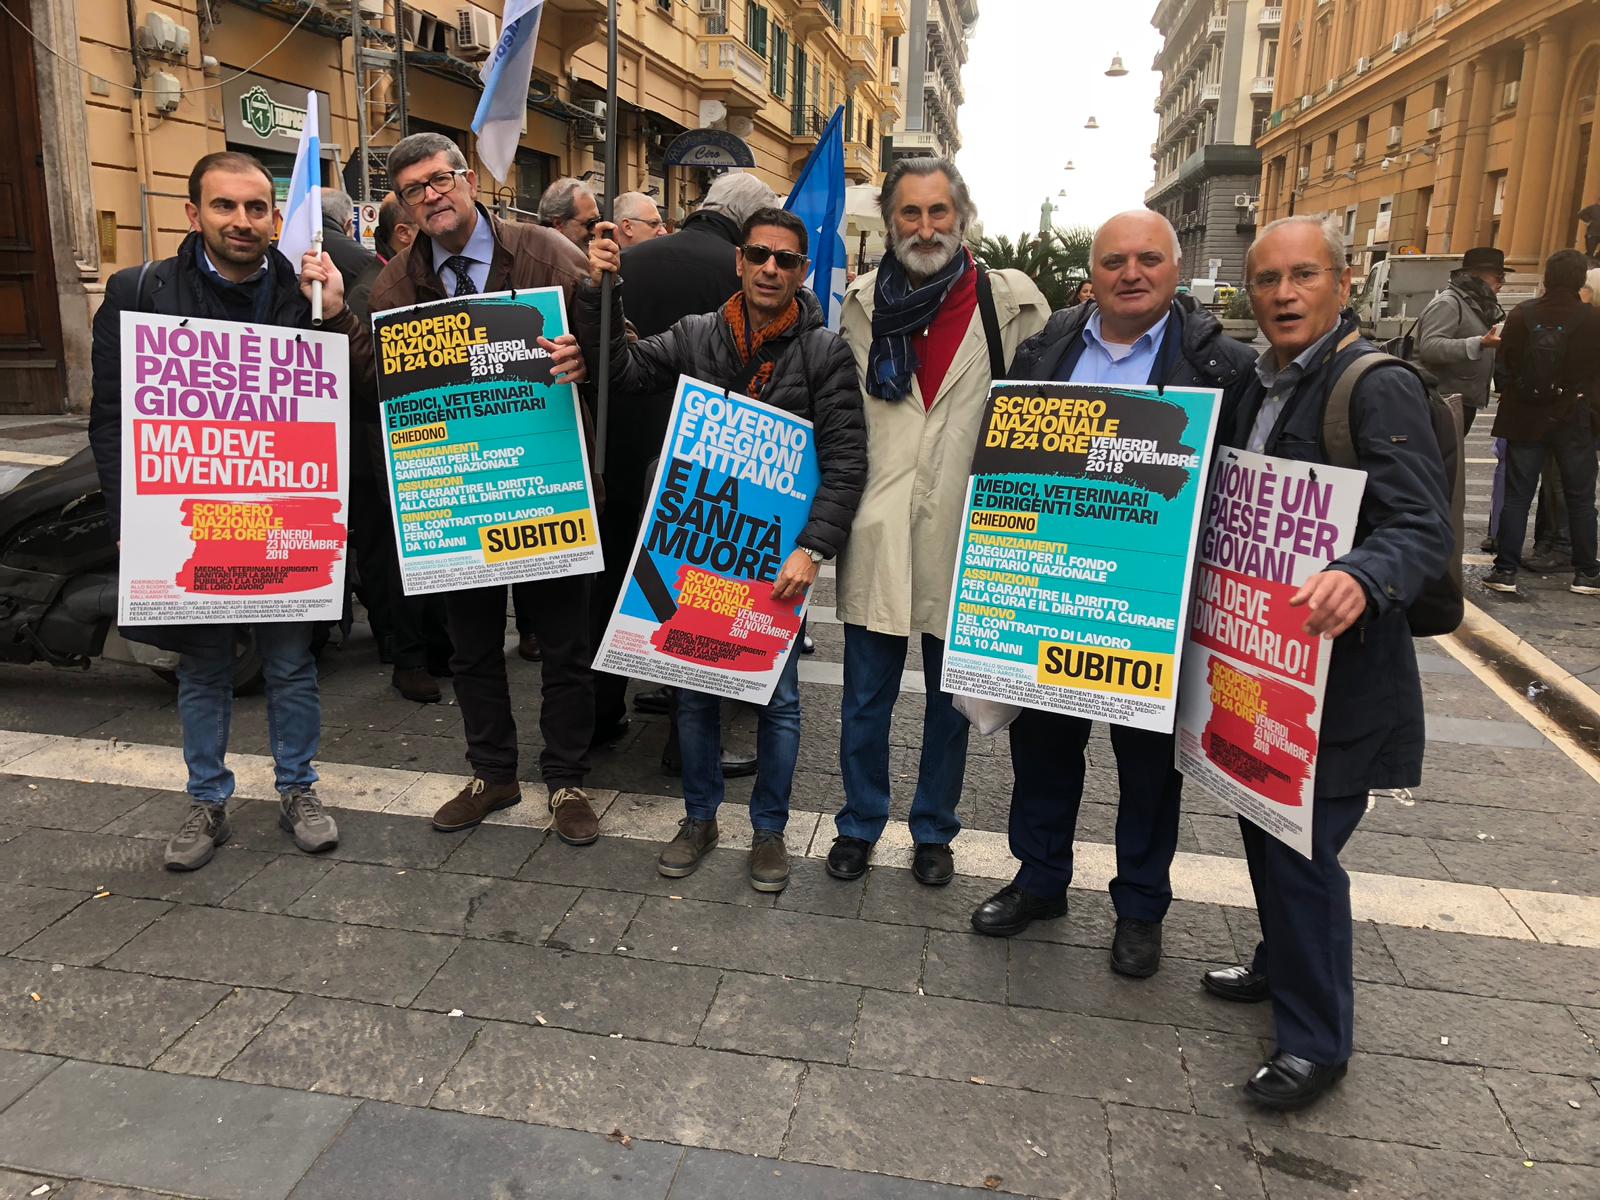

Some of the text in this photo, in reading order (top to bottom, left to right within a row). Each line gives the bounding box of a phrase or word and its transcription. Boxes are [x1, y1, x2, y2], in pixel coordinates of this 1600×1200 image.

[380, 312, 470, 343] SCIOPERO
[136, 325, 322, 369] NON È UN
[382, 327, 488, 359] NAZIONALE
[383, 347, 468, 374] DI 24 ORE
[470, 348, 551, 367] 23 NOVEMB
[471, 364, 504, 377] 2018
[136, 355, 338, 399] PAESE PER
[135, 386, 298, 422] GIOVANI
[387, 385, 534, 415] MEDICI, VETERINARI
[389, 398, 546, 428] E DIRIGENTI SANITARI
[993, 396, 1106, 418] SCIOPERO
[684, 391, 807, 451] GOVERNO
[989, 413, 1120, 438] NAZIONALE
[141, 424, 275, 458] MA DEVE
[391, 427, 445, 445] CHIEDONO
[678, 412, 803, 475] E REGIONI
[985, 430, 1090, 454] DI 24 ORE
[394, 442, 479, 460] FINANZIAMENTI
[394, 447, 524, 471] ADEGUATI PER IL FONDO
[1088, 449, 1200, 468] 23 NOVEMBRE
[141, 454, 328, 488] DIVENTARLO!
[395, 457, 519, 480] SANITARIO NAZIONALE
[673, 435, 807, 501] LATITANO...
[1086, 461, 1124, 474] 2018
[398, 476, 464, 492] ASSUNZIONI
[398, 476, 544, 501] PER GARANTIRE IL DIRITTO
[400, 481, 584, 511] ALLA CURA E IL DIRITTO A CURARE
[666, 459, 738, 511] E LA
[976, 479, 1149, 507] MEDICI, VETERINARI
[1214, 460, 1333, 520] NON È UN
[192, 504, 273, 517] SCIOPERO
[193, 516, 283, 529] NAZIONALE
[401, 509, 452, 523] RINNOVO
[403, 506, 554, 532] DEL CONTRATTO DI LAVORO
[656, 490, 781, 556] SANITÀ
[971, 512, 1036, 531] CHIEDONO
[973, 494, 1159, 525] E DIRIGENTI SANITARI
[192, 528, 267, 541] DI 24 ORE
[404, 530, 443, 542] FERMO
[486, 518, 586, 553] SUBITO!
[1209, 494, 1339, 562] PAESE PER
[266, 540, 339, 549] 23 NOVEMBRE
[266, 550, 288, 560] 2018
[406, 537, 467, 551] DA 10 ANNI
[648, 520, 781, 582] MUORE
[968, 533, 1068, 555] FINANZIAMENTI
[1203, 527, 1296, 585] GIOVANI
[965, 555, 1107, 582] SANITARIO NAZIONALE
[966, 544, 1117, 572] ADEGUATI PER IL FONDO
[685, 570, 749, 597] SCIOPERO
[963, 568, 1039, 587] ASSUNZIONI
[678, 593, 737, 618] DI 24 ORE
[682, 582, 755, 610] NAZIONALE
[962, 579, 1129, 611] PER GARANTIRE IL DIRITTO
[1199, 567, 1271, 626] MA DEVE
[958, 602, 1016, 620] RINNOVO
[960, 590, 1175, 630] ALLA CURA E IL DIRITTO A CURARE
[729, 627, 747, 639] 2018
[732, 618, 792, 640] 23 NOVEMBRE
[956, 624, 1000, 640] FERMO
[957, 614, 1131, 649] DEL CONTRATTO DI LAVORO
[1194, 599, 1310, 678] DIVENTARLO!
[954, 636, 1023, 656] DA 10 ANNI
[1045, 646, 1163, 692] SUBITO!
[1213, 661, 1261, 696] SCIOPERO
[1050, 697, 1134, 716] COORDINAMENTO NAZIONALE
[1210, 691, 1256, 725] DI 24 ORE
[1212, 676, 1268, 716] NAZIONALE
[1253, 737, 1270, 755] 2018
[1254, 725, 1264, 739] 23
[1264, 730, 1310, 762] NOVEMBRE
